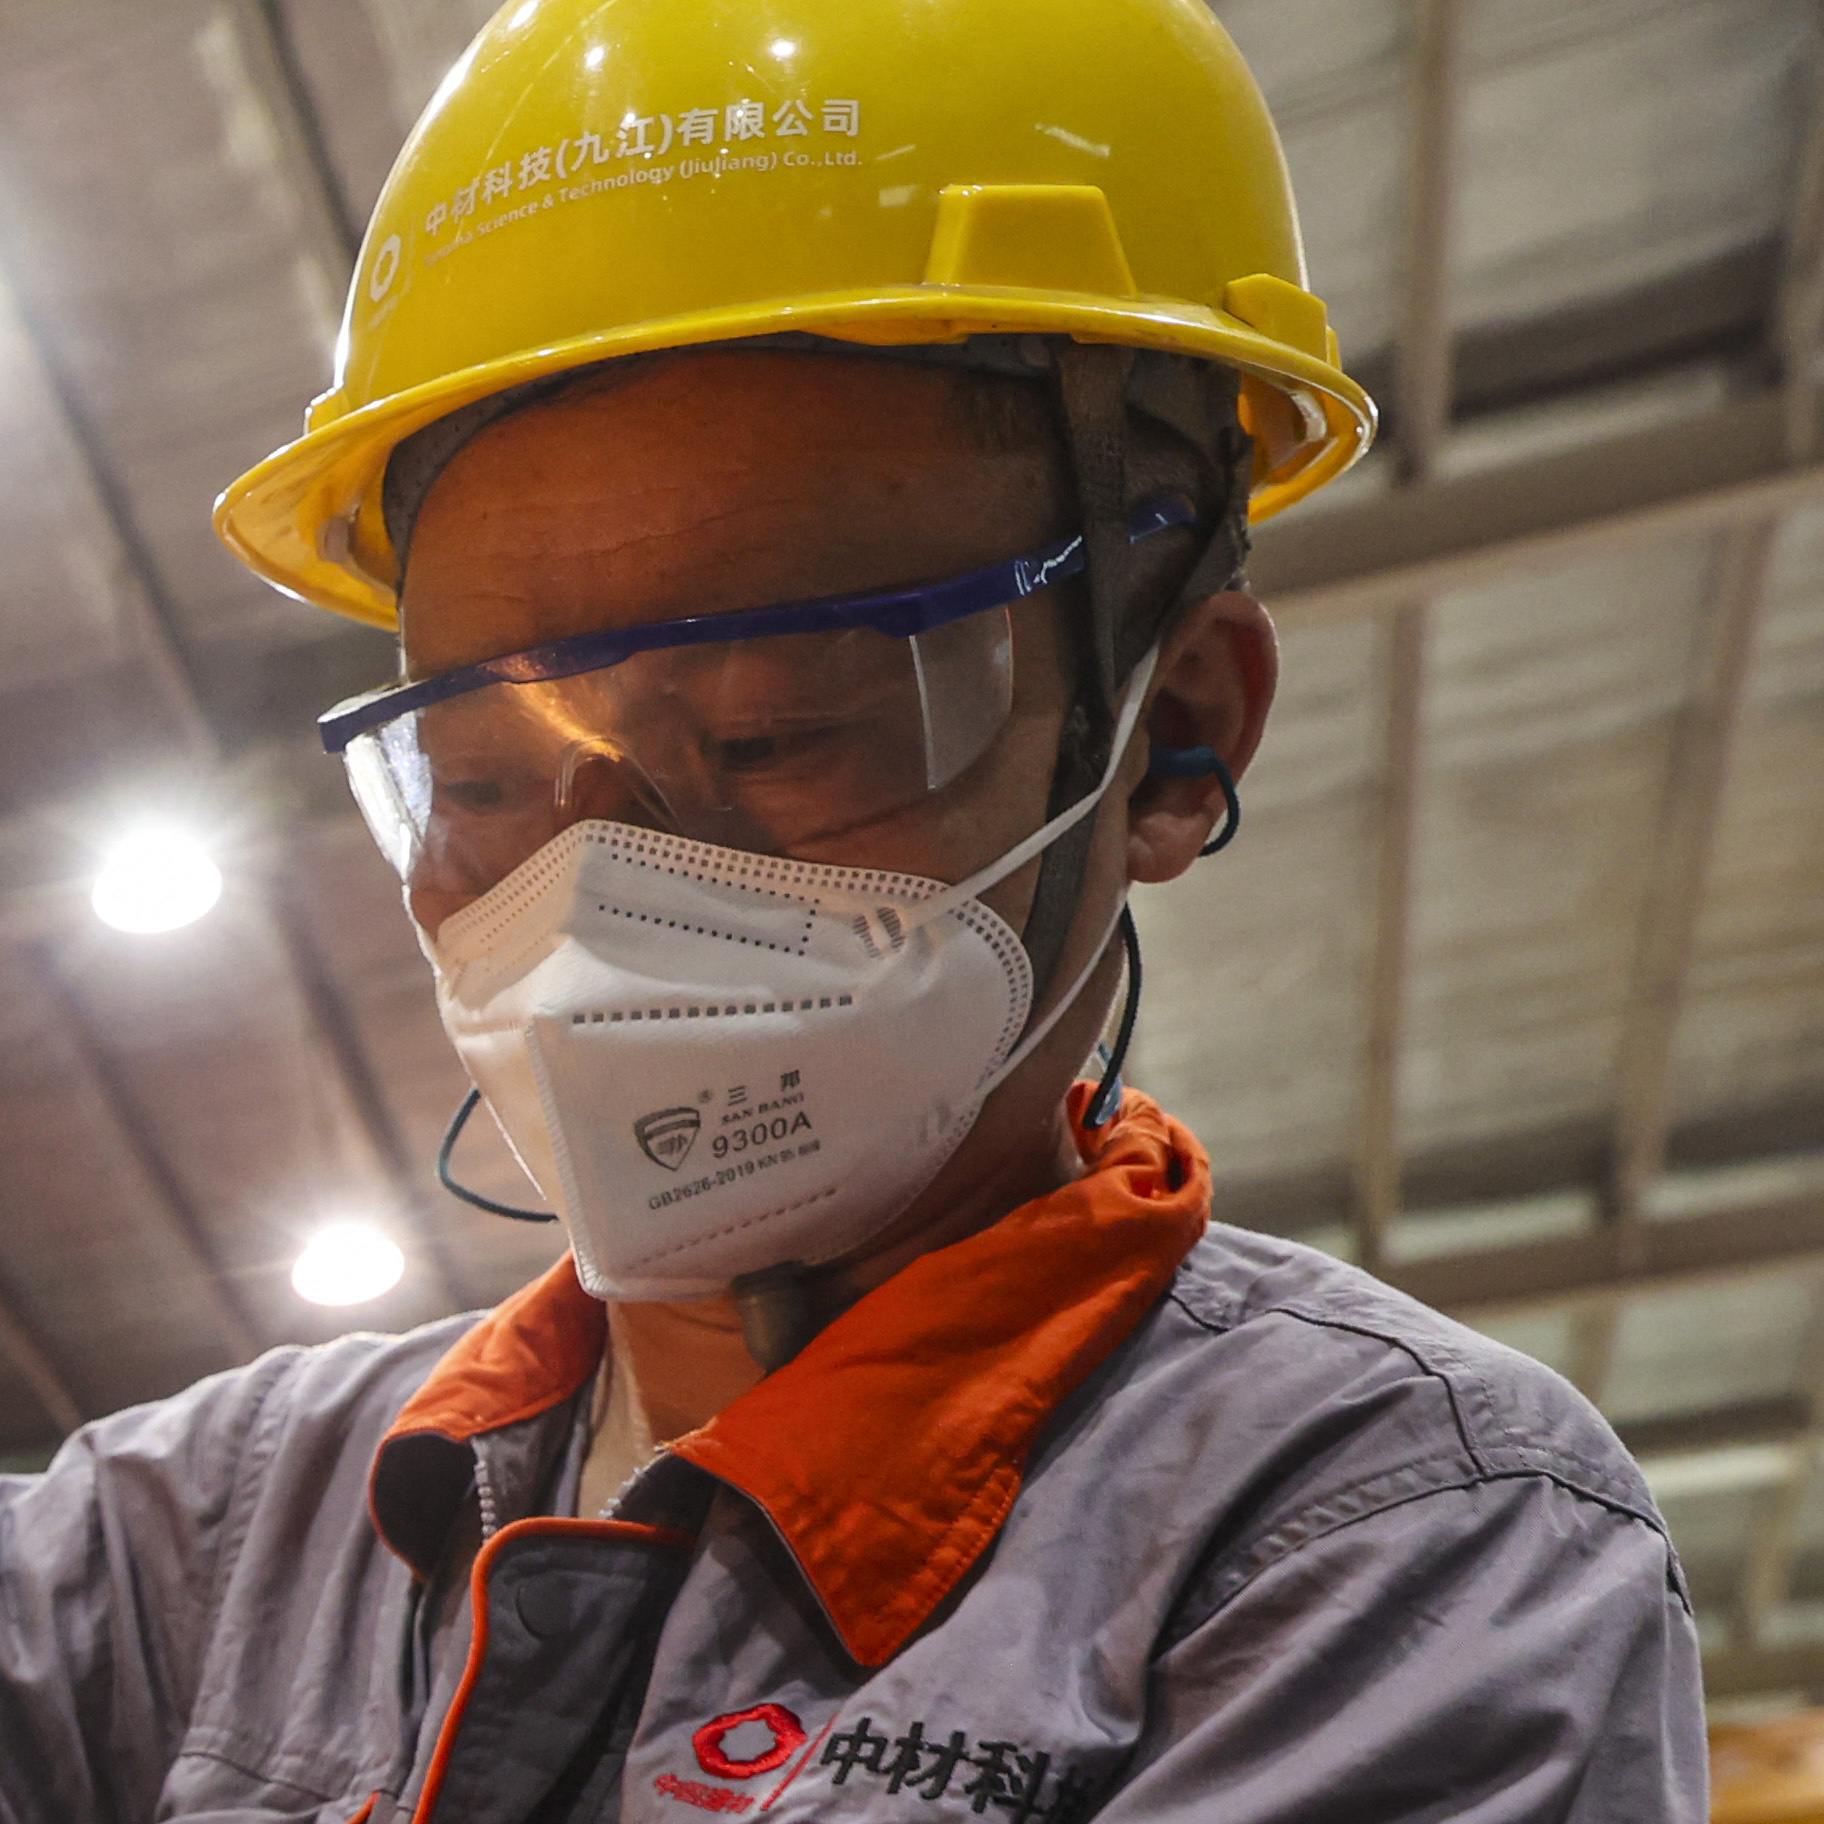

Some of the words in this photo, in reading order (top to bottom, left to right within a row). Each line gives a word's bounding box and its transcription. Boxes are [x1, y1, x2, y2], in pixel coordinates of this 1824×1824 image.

[425, 98, 861, 237] 中材科技(九江)有限公司
[476, 202, 539, 236] Science
[542, 193, 555, 210] &
[558, 165, 674, 203] Technology
[712, 1111, 812, 1160] 9300A
